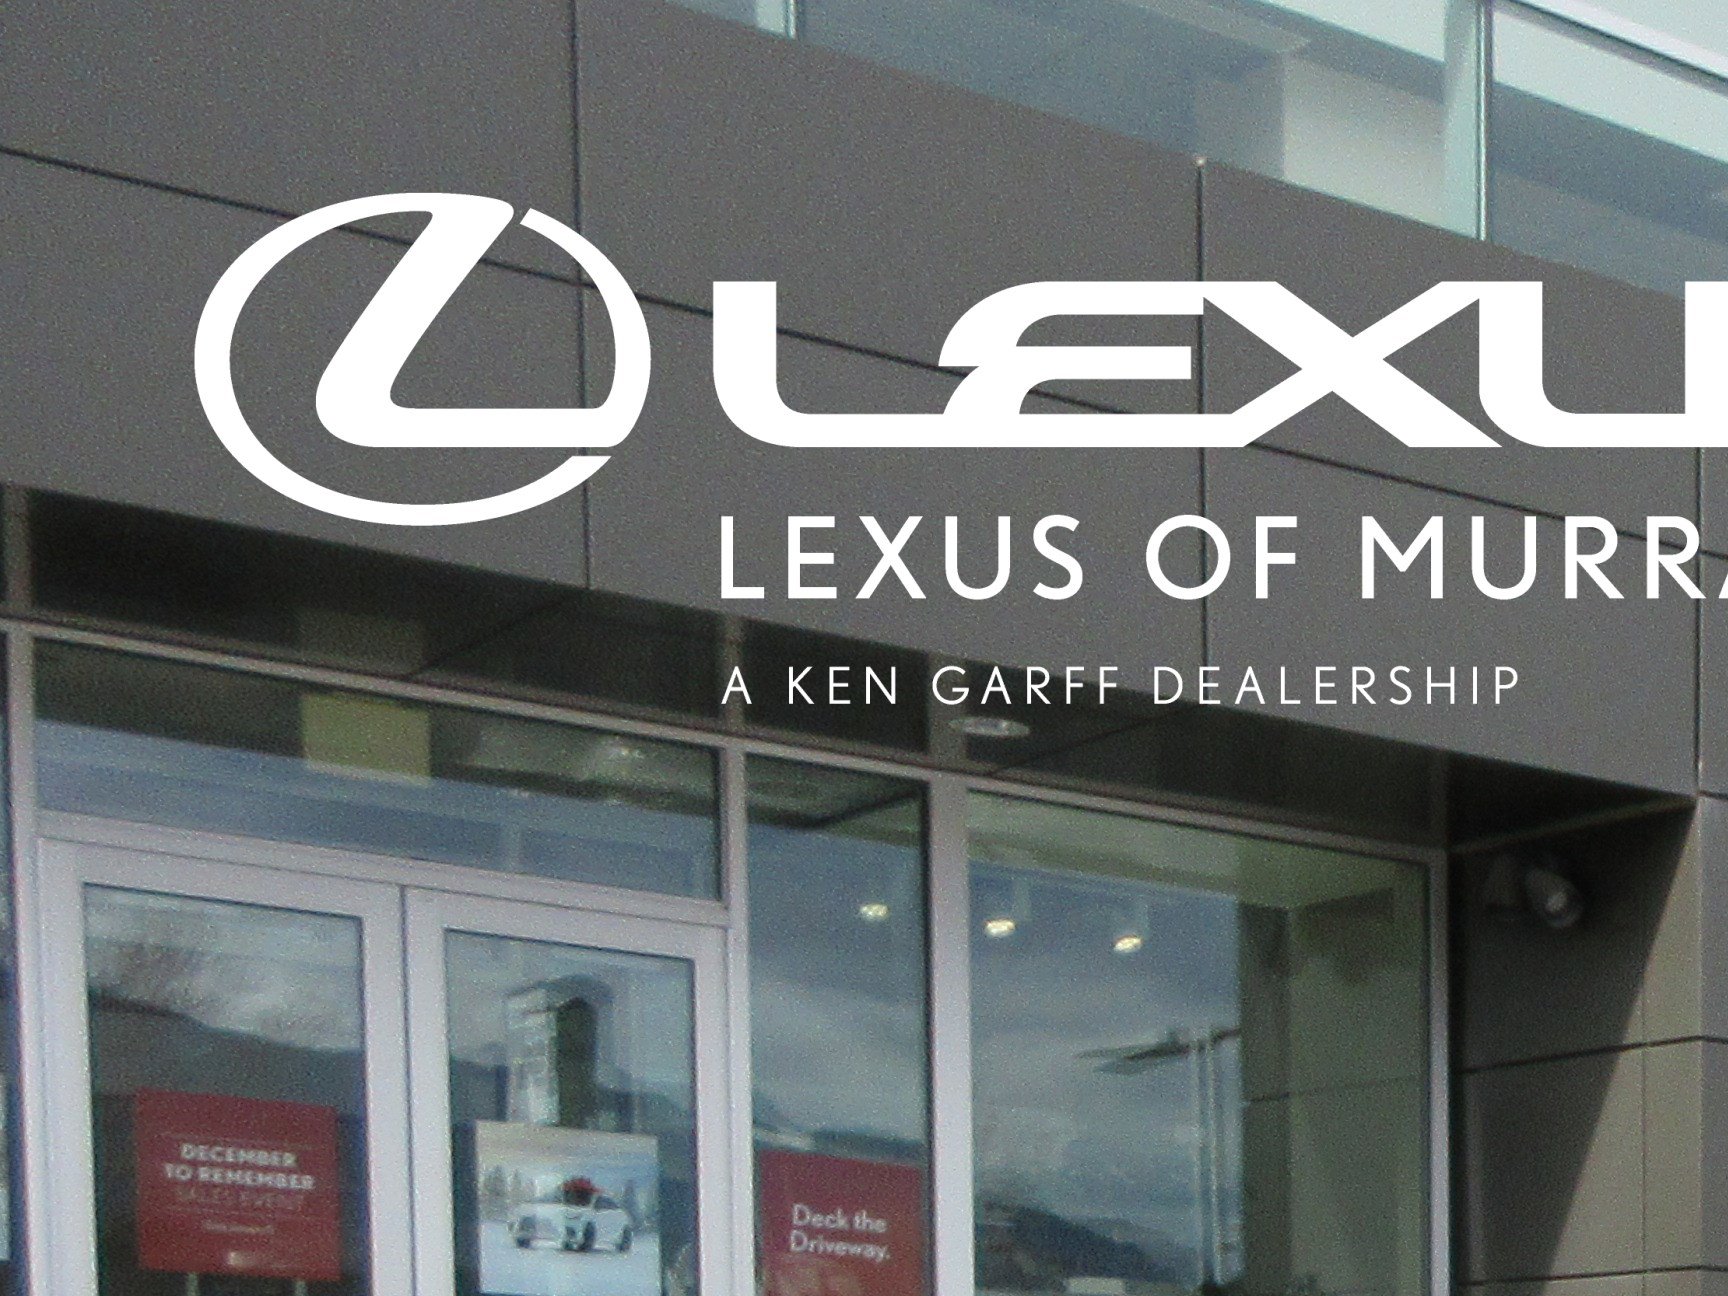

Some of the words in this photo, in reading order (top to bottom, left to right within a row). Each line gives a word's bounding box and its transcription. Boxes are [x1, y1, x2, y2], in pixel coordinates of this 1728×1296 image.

[181, 1142, 297, 1166] DECEMBER
[164, 1162, 193, 1182] TO
[198, 1167, 315, 1190] REMEMBER
[792, 1204, 848, 1230] Deck
[853, 1210, 887, 1232] the
[790, 1230, 891, 1263] Driveway.
